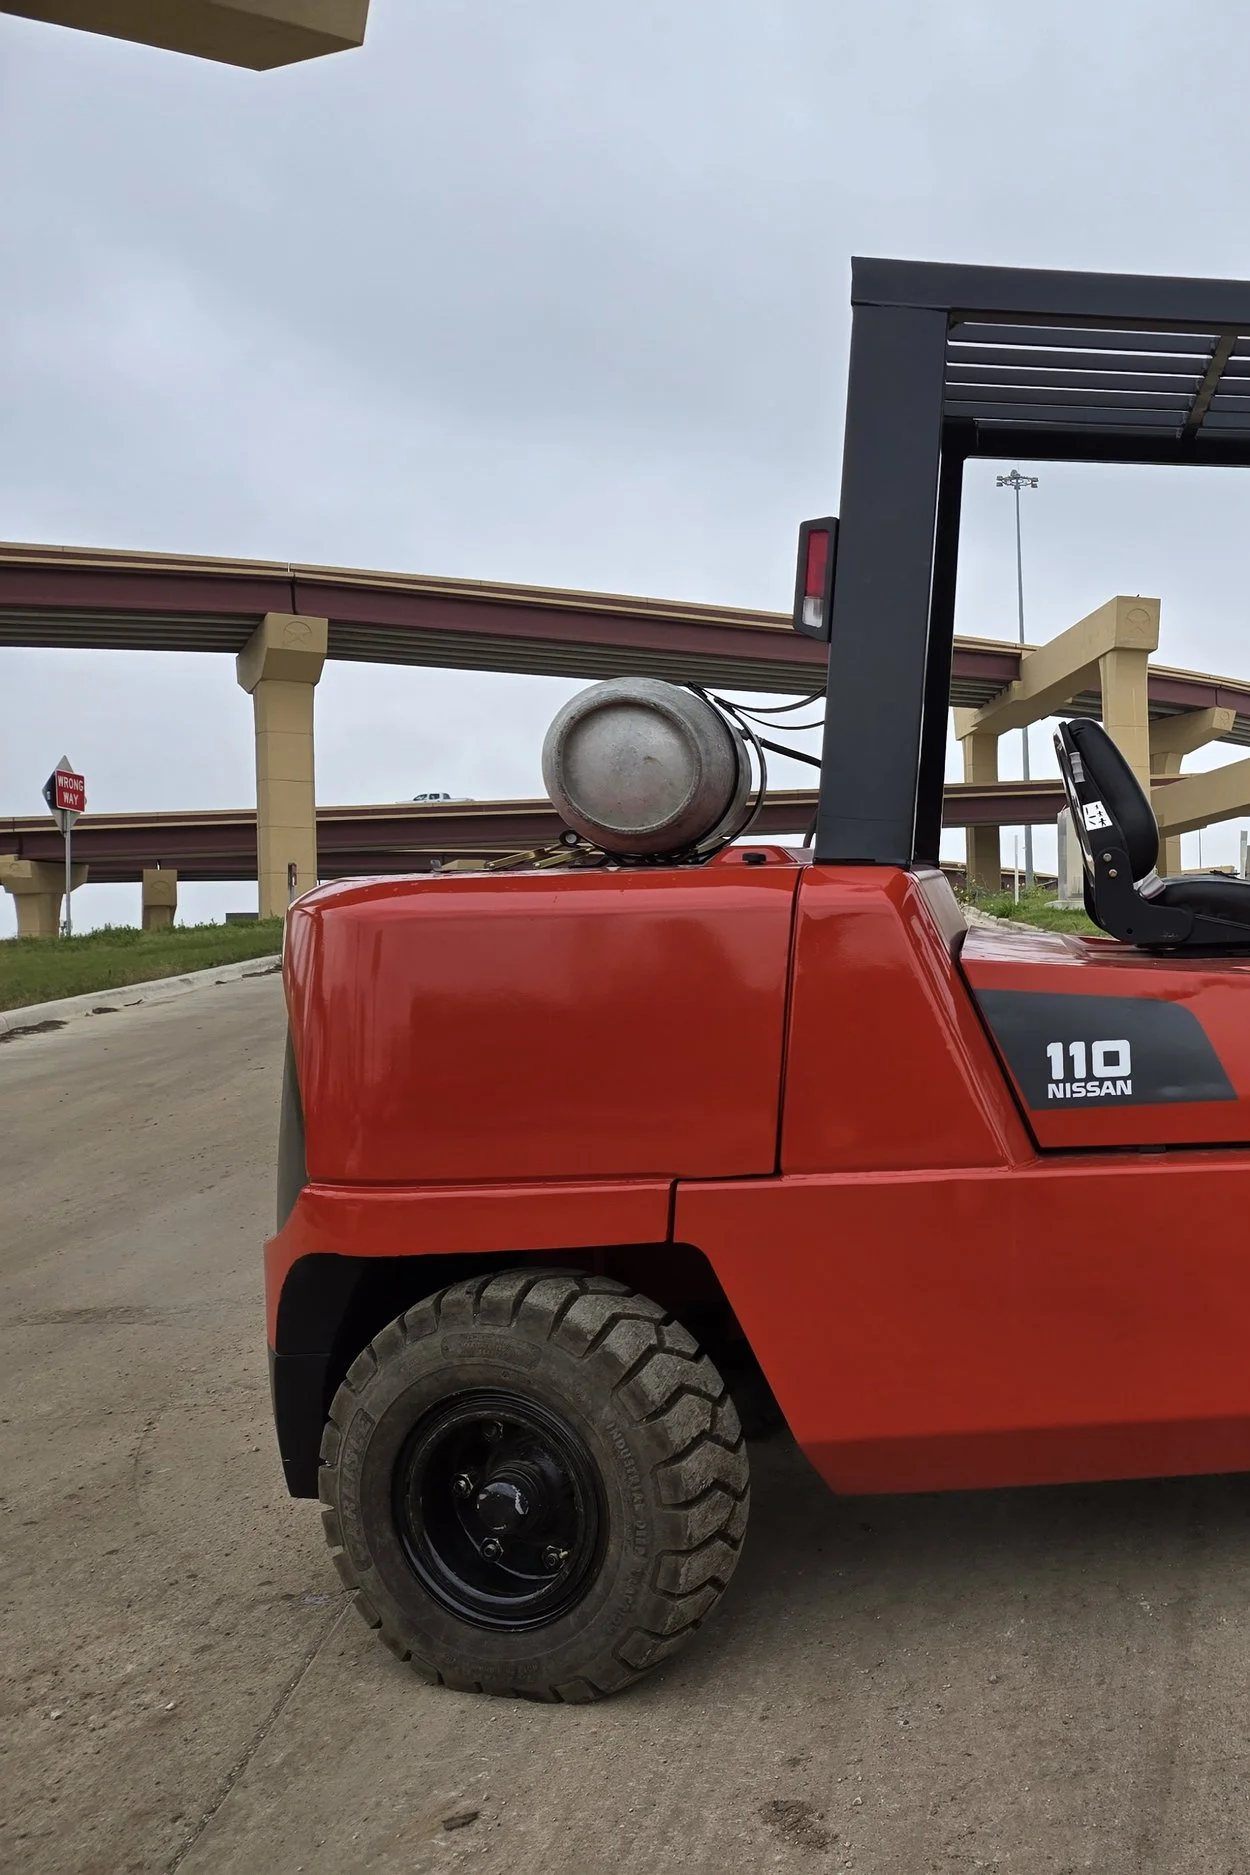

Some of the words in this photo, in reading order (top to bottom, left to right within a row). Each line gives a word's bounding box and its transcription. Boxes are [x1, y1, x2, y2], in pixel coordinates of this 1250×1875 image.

[58, 775, 83, 792] WRONG
[63, 791, 79, 806] WAY
[1046, 1039, 1131, 1080] 110
[1047, 1080, 1132, 1099] NISSAN
